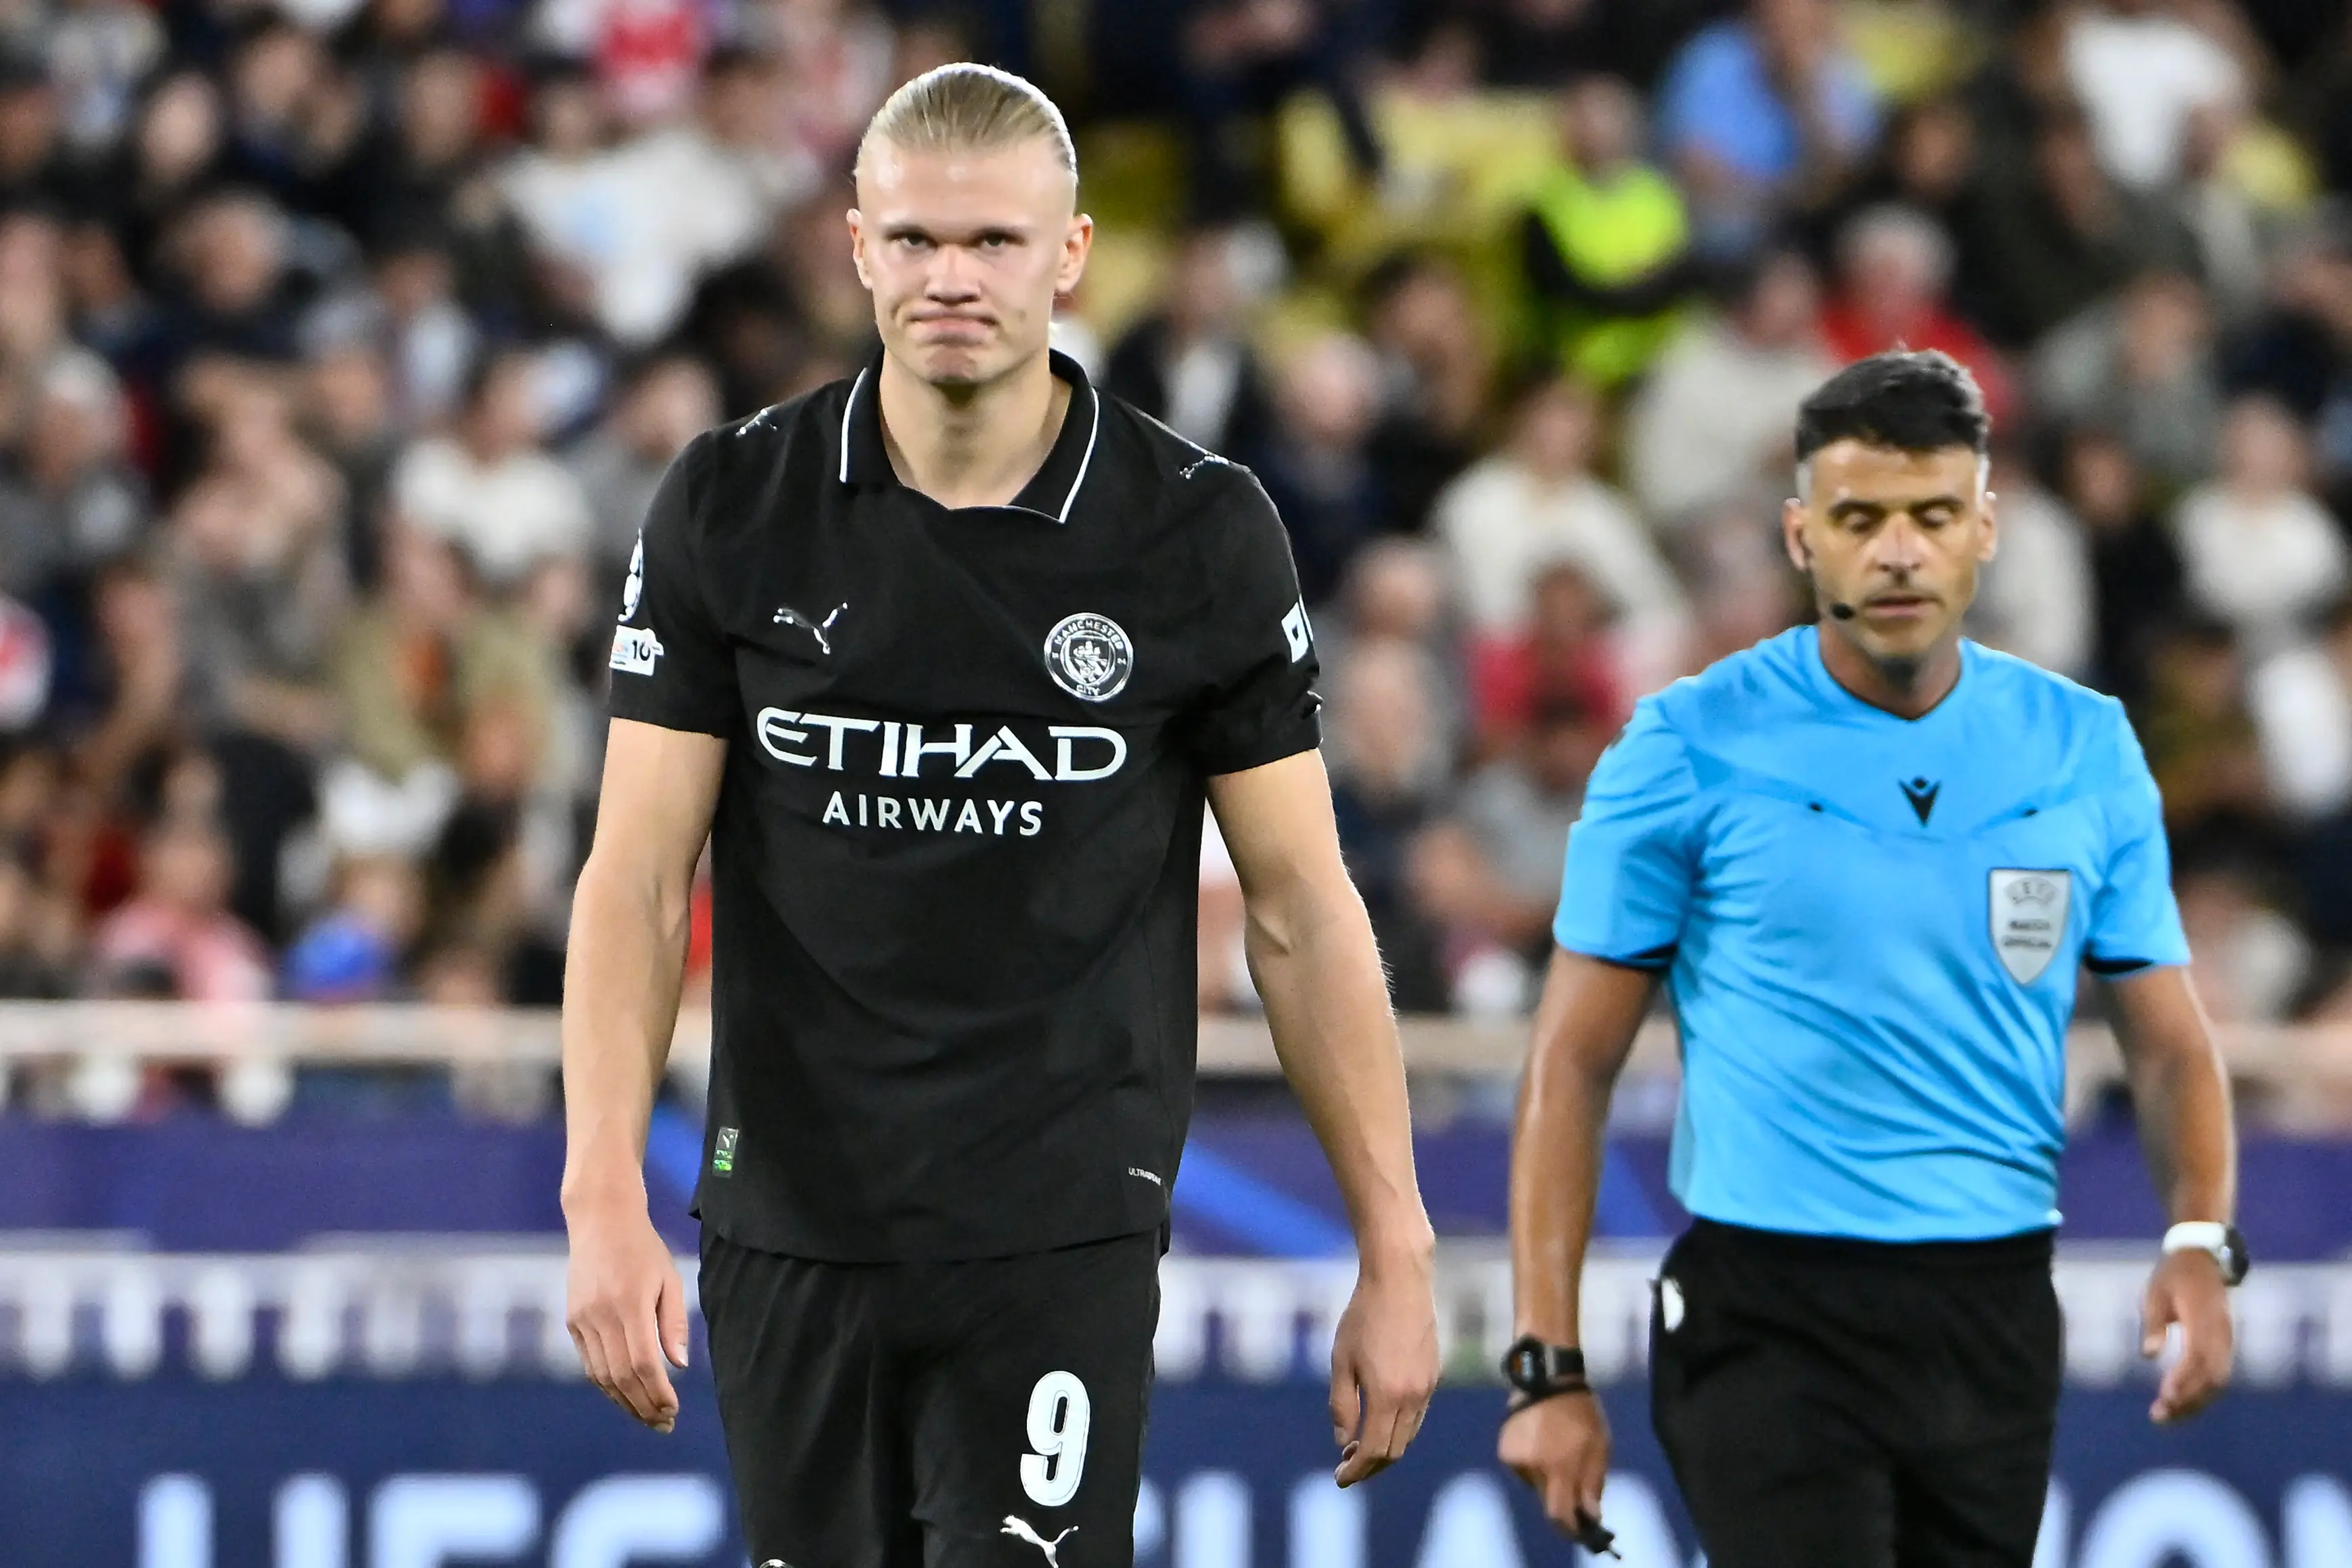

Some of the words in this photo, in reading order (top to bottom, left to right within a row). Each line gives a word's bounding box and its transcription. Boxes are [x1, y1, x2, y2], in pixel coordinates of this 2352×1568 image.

[1054, 619, 1124, 649] MANCHESTER
[1076, 683, 1101, 696] CITY
[756, 706, 1128, 782] ETIHAD
[822, 790, 1043, 837] AIRWAYS
[1020, 1370, 1091, 1507] 9
